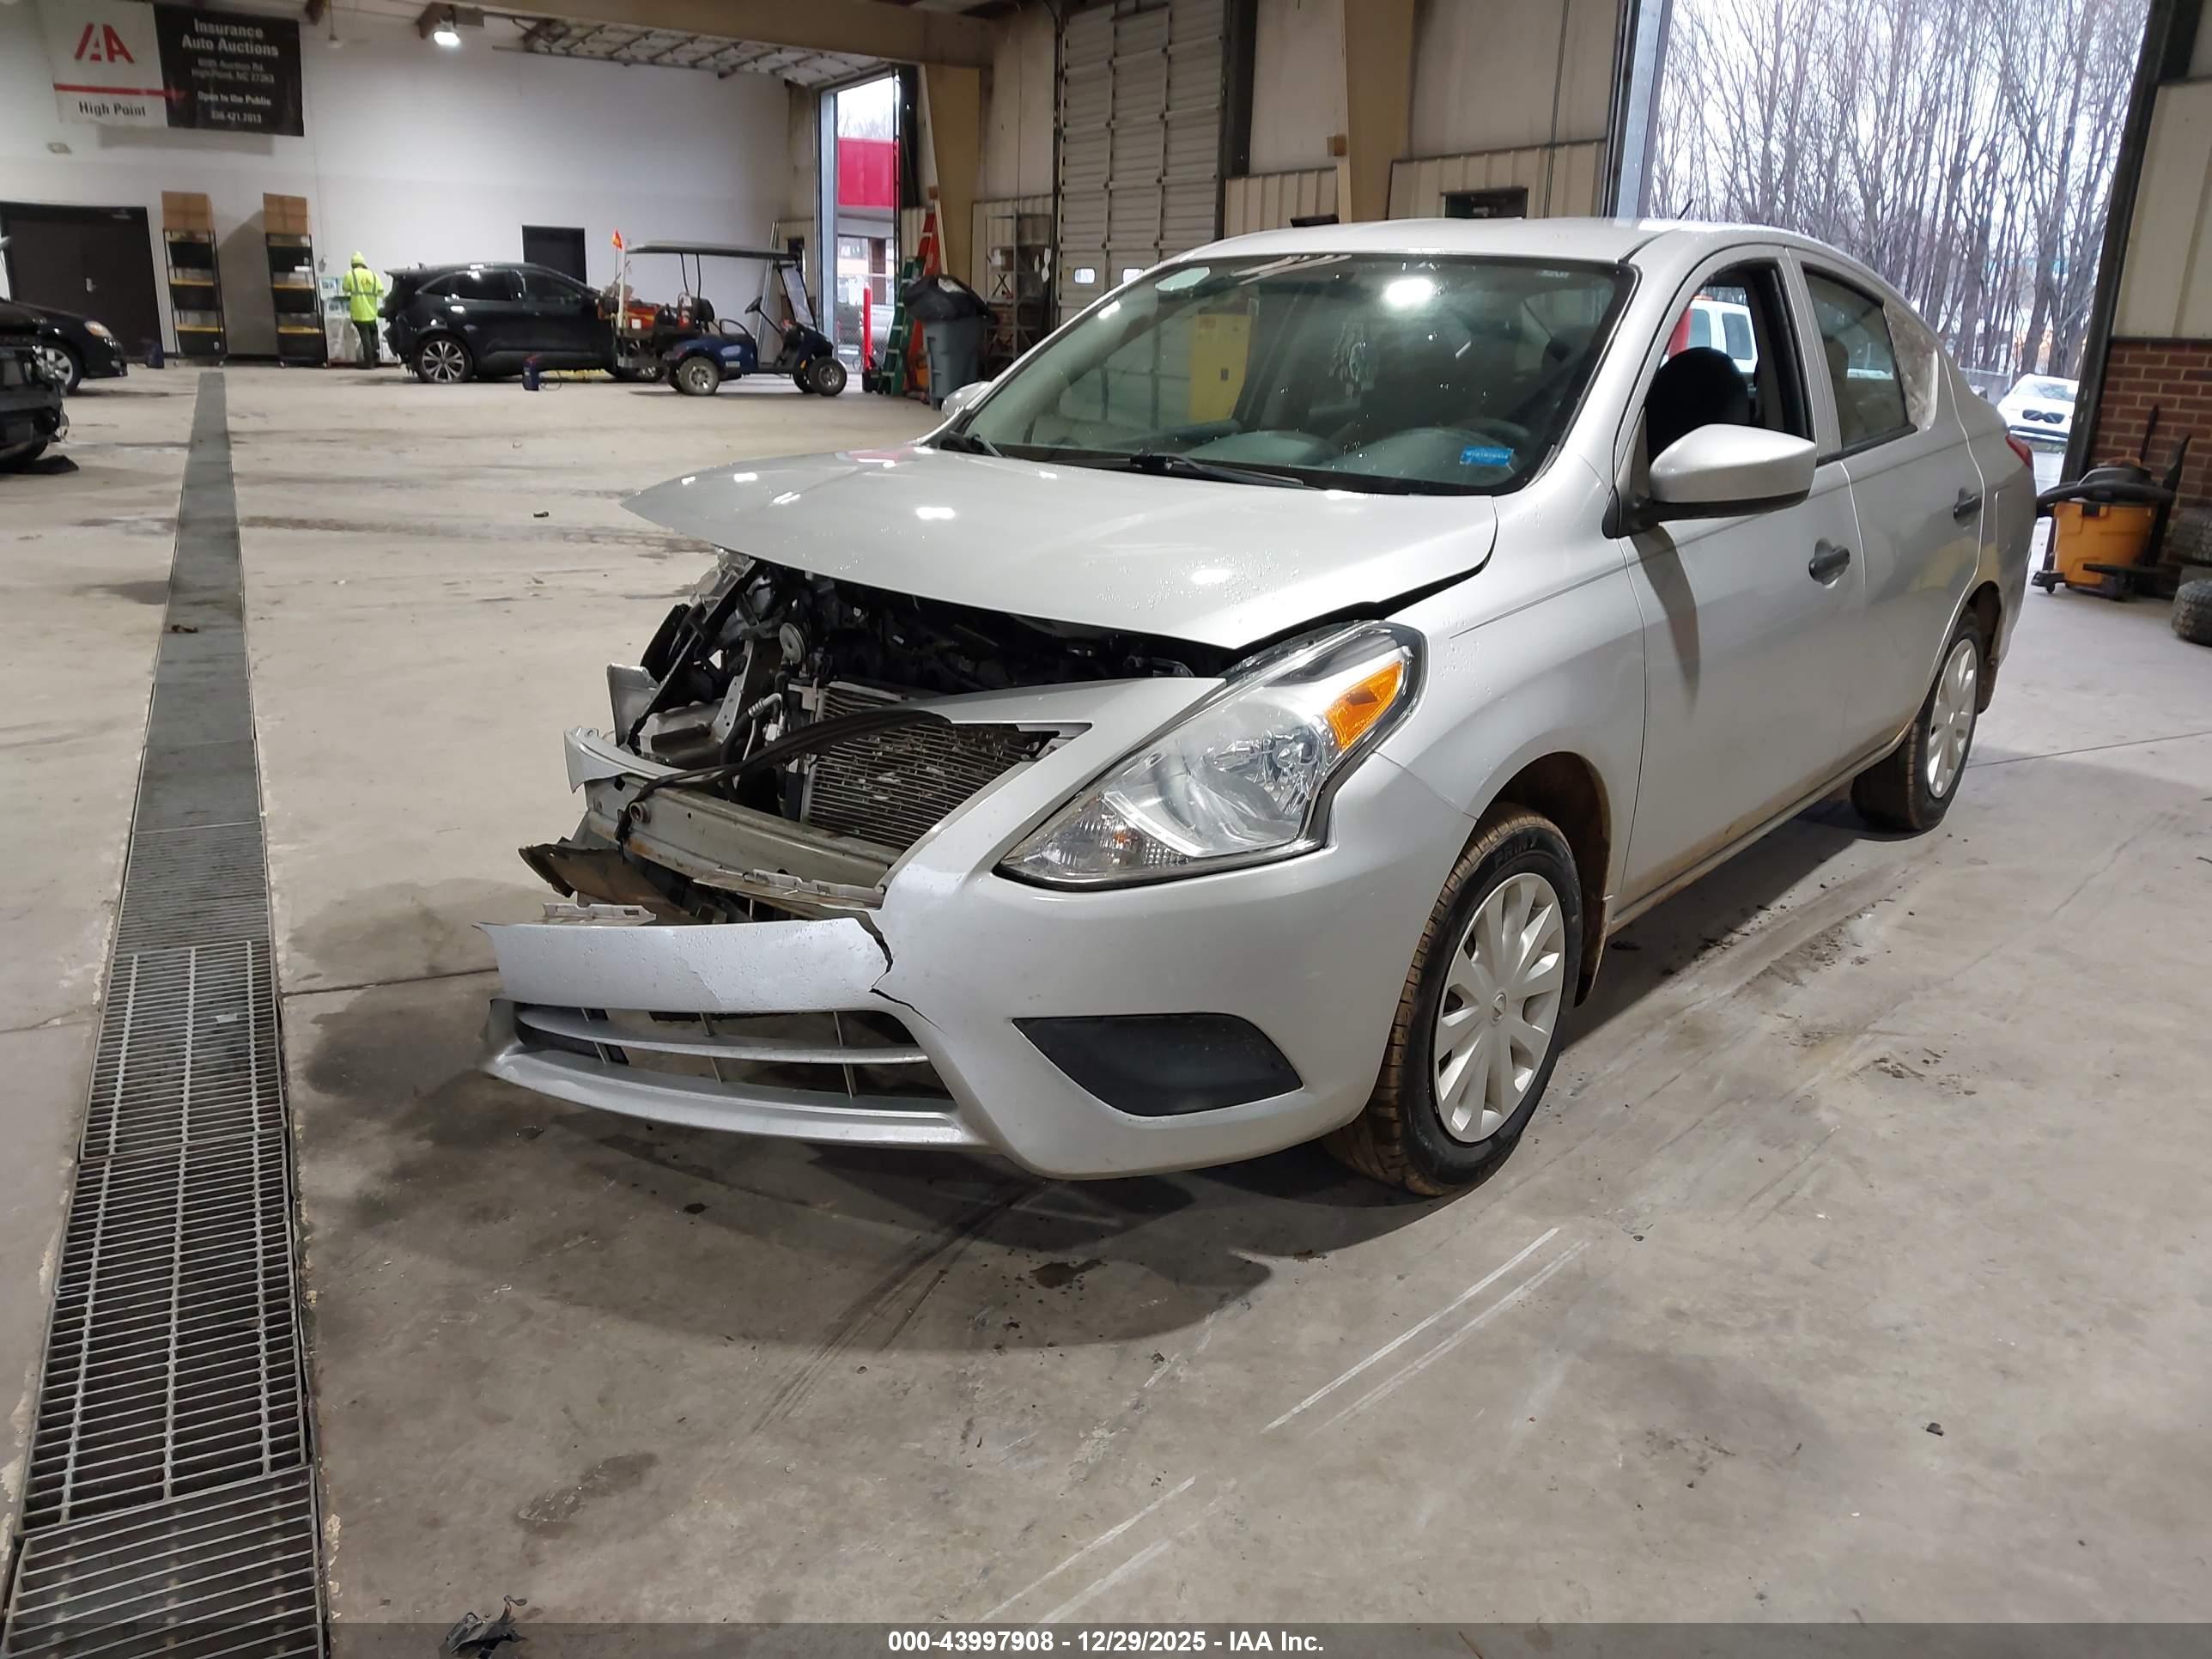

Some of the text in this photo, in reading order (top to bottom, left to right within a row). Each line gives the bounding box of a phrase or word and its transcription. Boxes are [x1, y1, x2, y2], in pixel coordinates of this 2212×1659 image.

[193, 17, 264, 40] Insurance
[182, 33, 279, 58] Auto Auctions
[198, 90, 272, 106] Open to the Public
[78, 100, 147, 118] High Point
